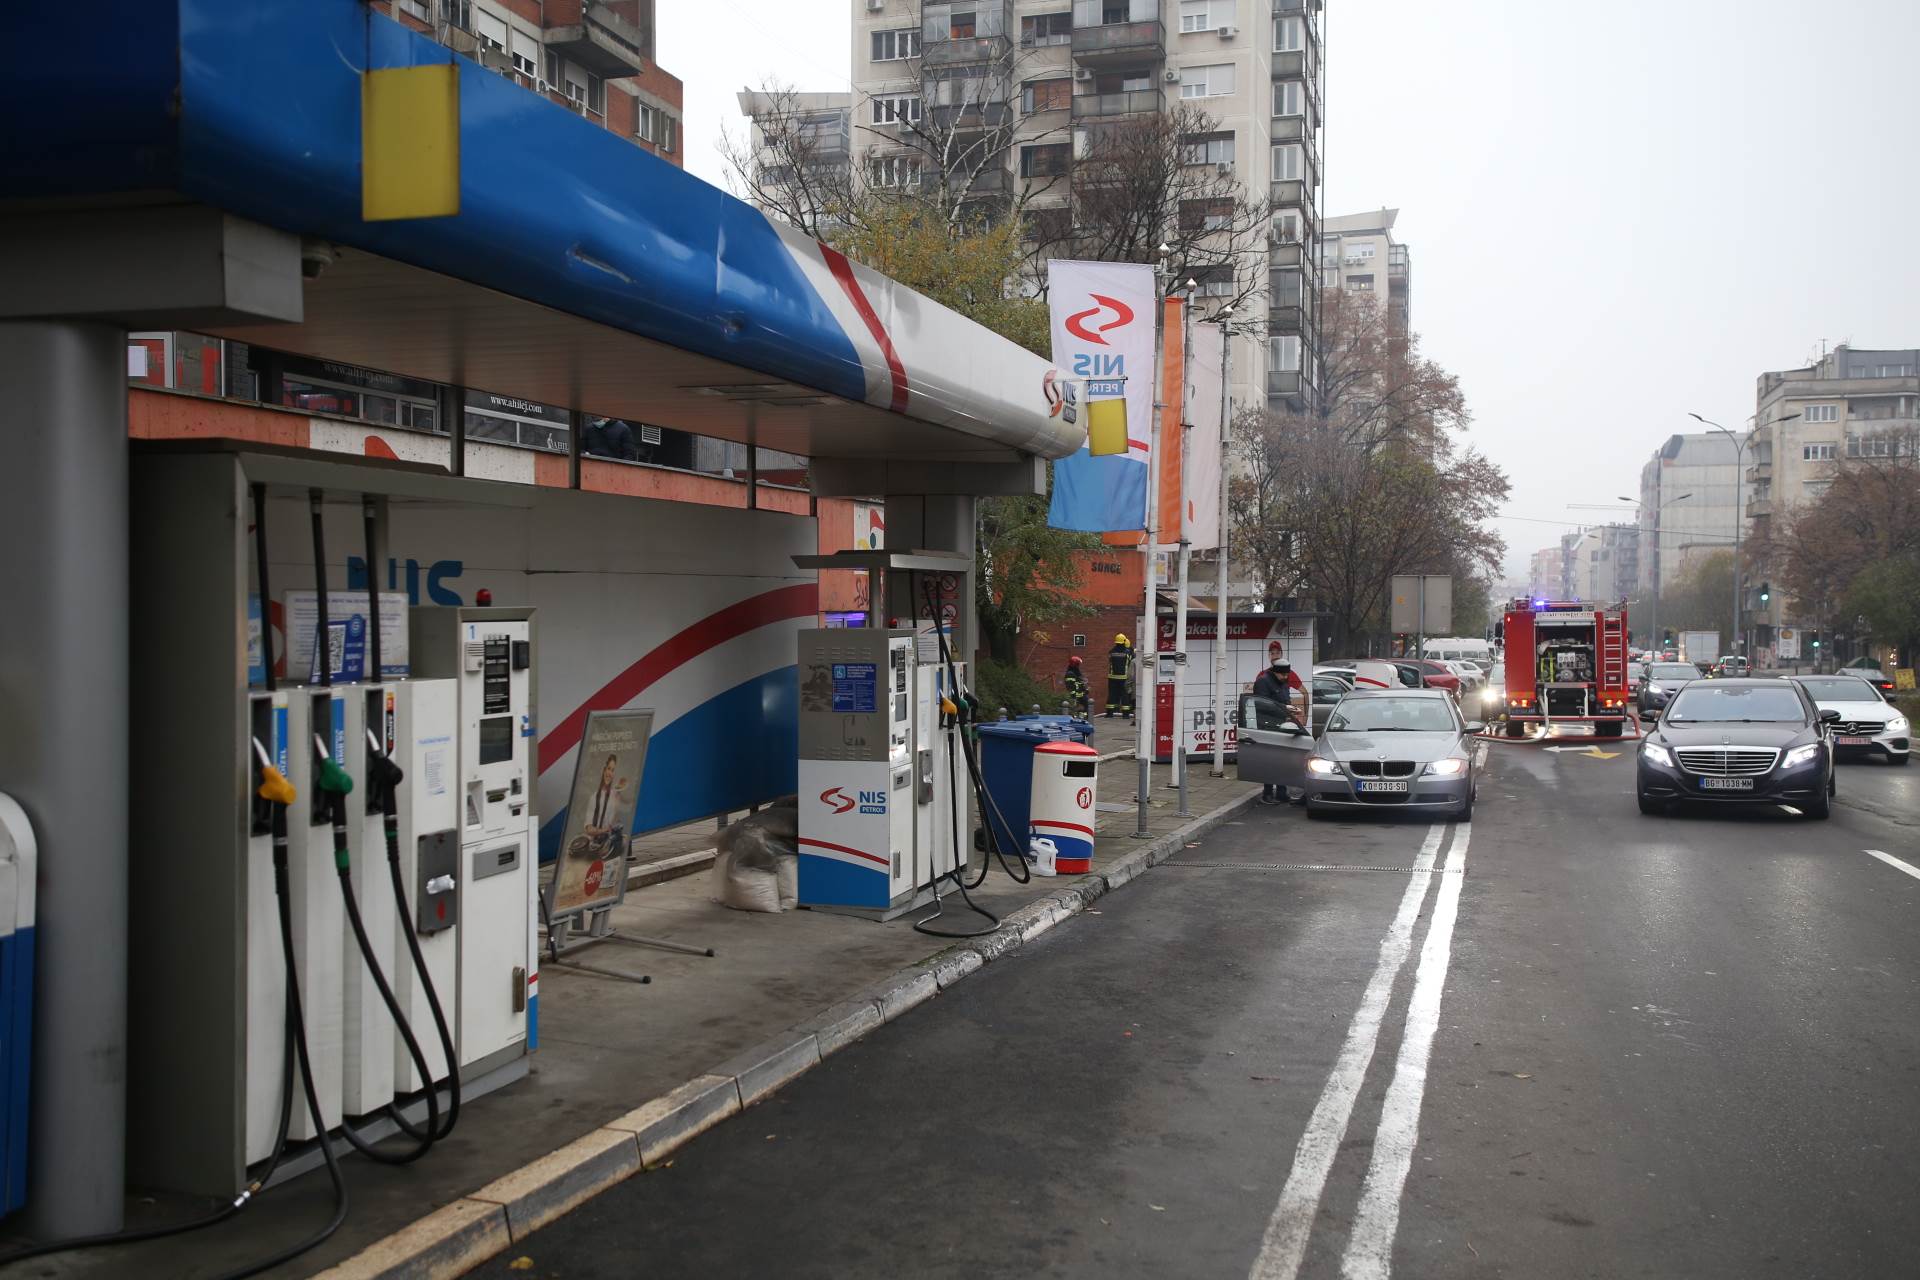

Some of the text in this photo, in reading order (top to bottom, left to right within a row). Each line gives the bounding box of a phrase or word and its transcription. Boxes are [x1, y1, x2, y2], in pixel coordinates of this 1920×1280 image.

[469, 624, 476, 639] 1
[859, 791, 886, 804] NIS
[862, 806, 884, 814] PETROL
